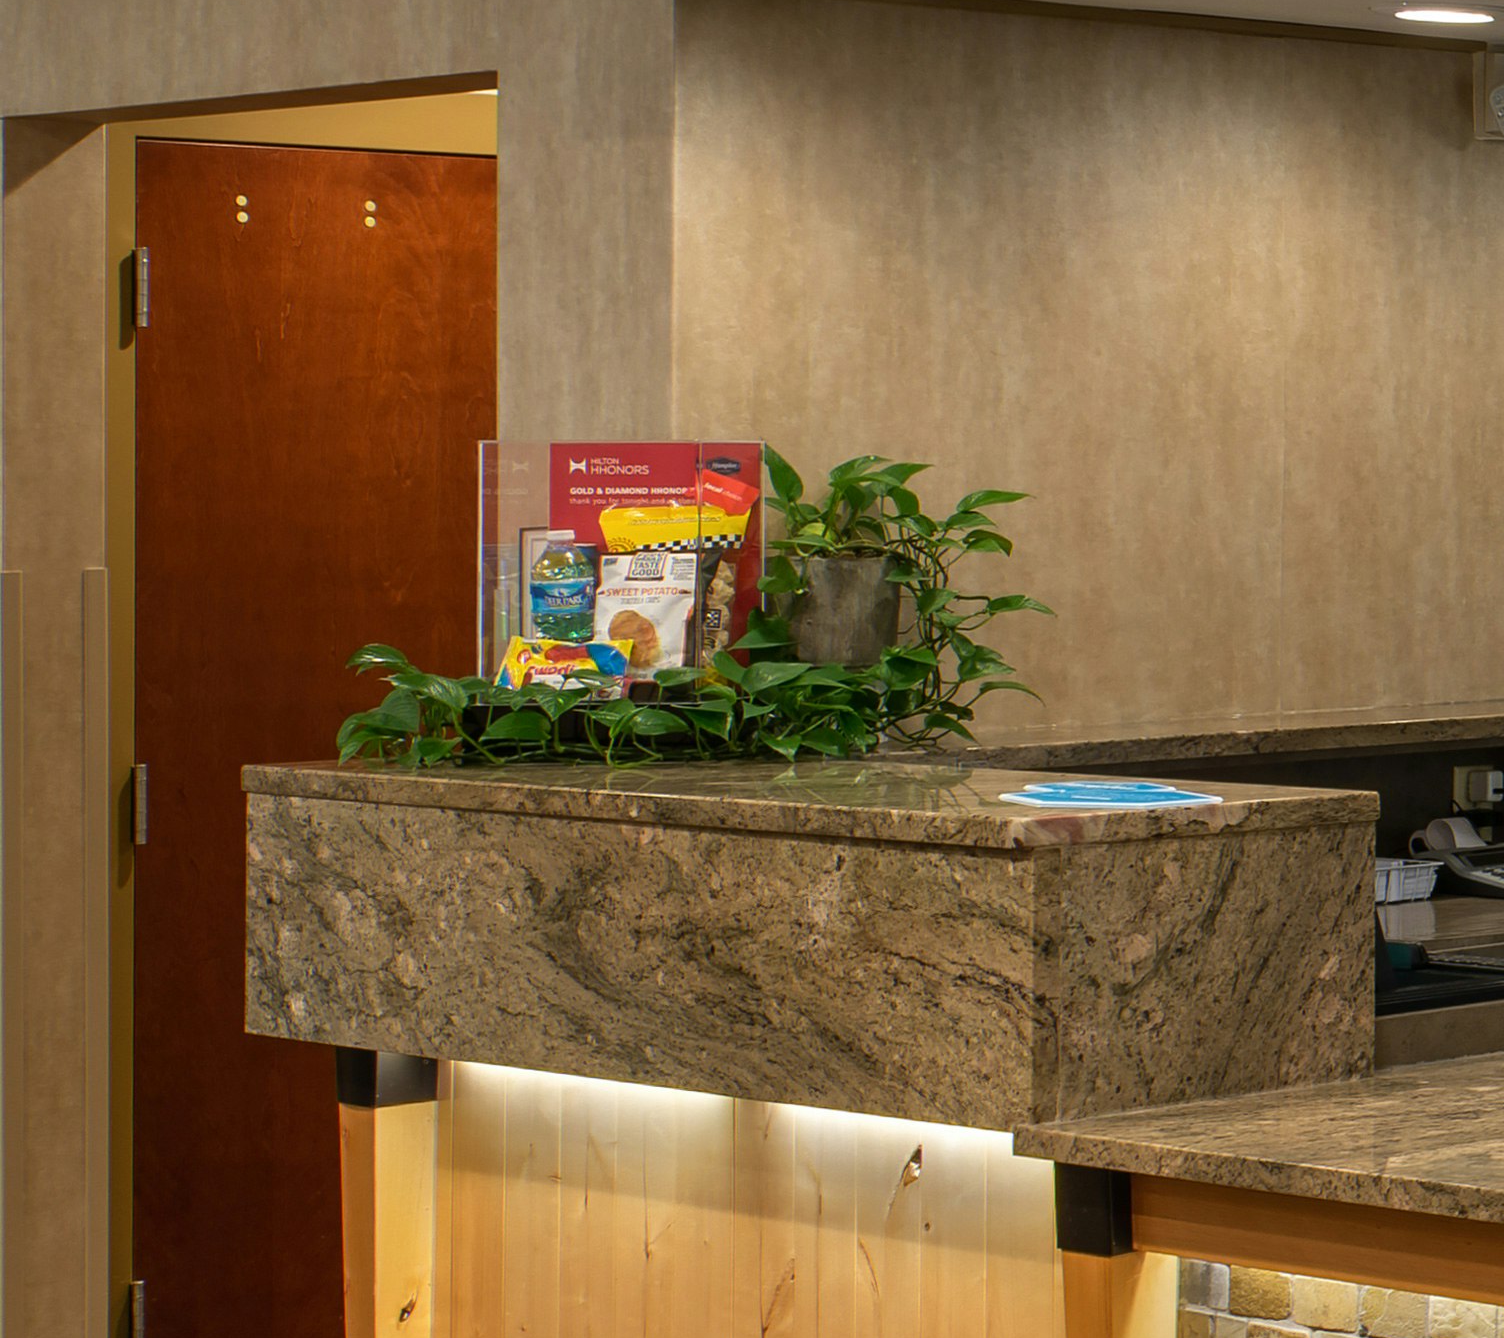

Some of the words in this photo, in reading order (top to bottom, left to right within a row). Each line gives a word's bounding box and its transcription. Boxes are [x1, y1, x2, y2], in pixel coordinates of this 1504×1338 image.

[591, 457, 620, 466] HILTON
[591, 463, 650, 476] HHONORS
[570, 487, 595, 495] GOLD
[605, 487, 649, 495] DIAMOND
[631, 568, 660, 577] GOOD
[606, 587, 639, 597] SWEET
[640, 587, 680, 597] POTATO
